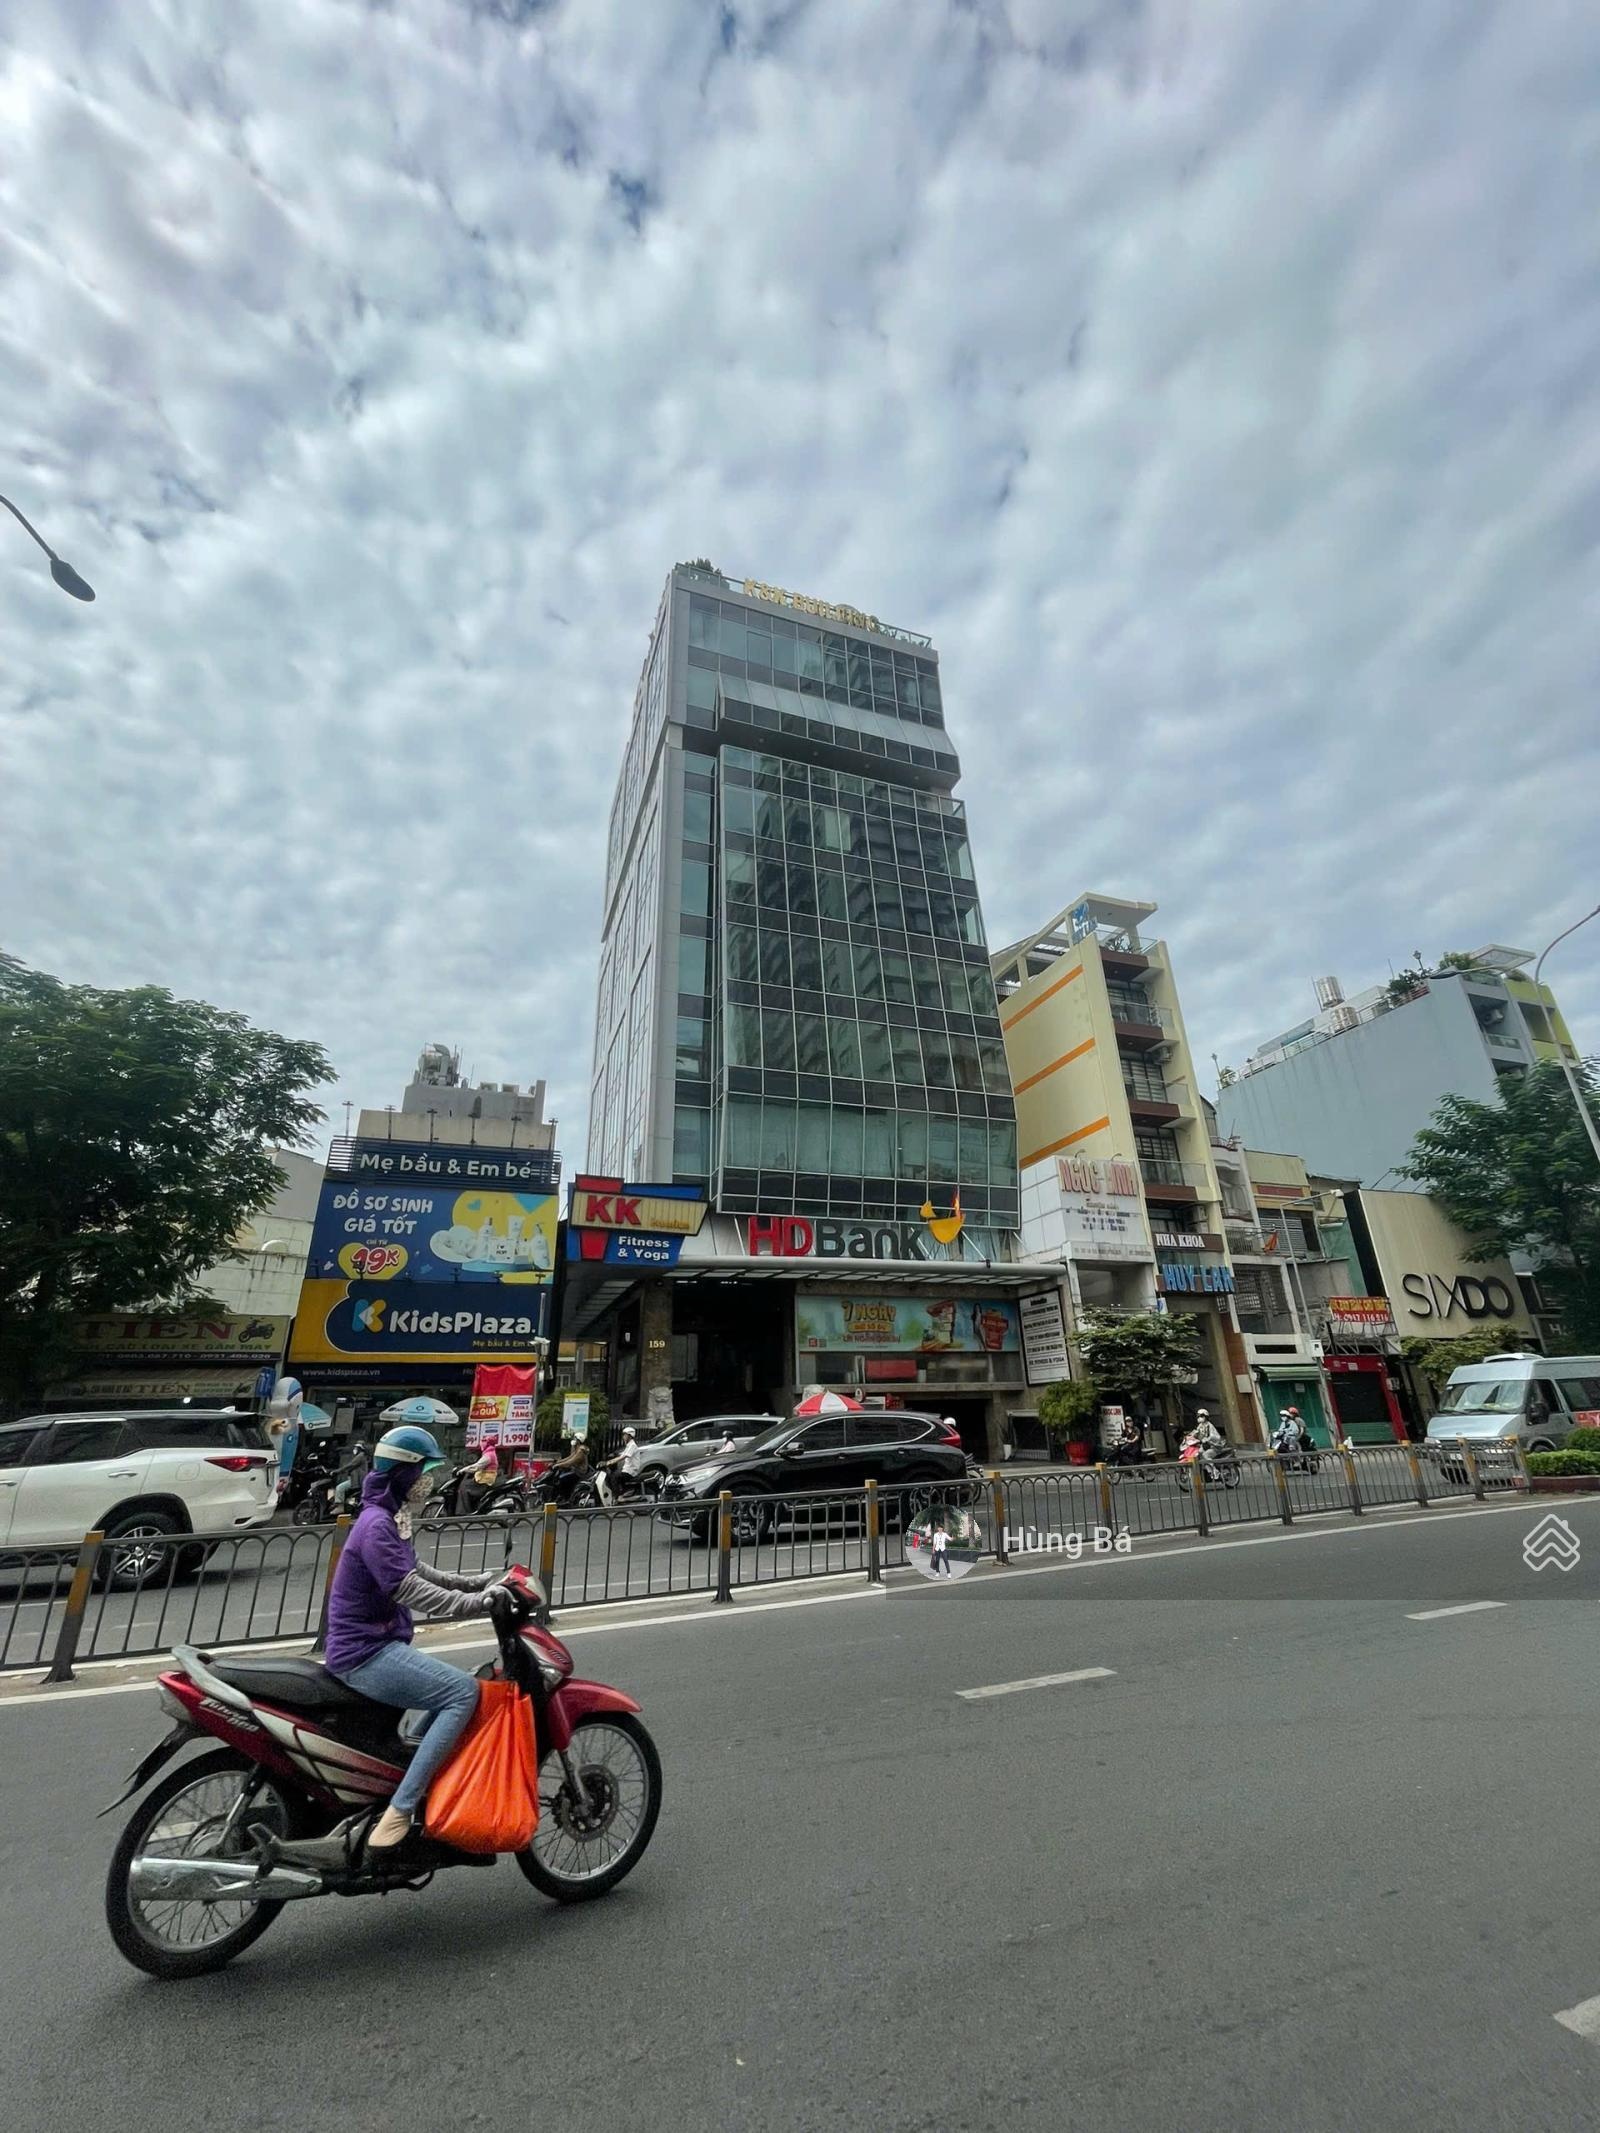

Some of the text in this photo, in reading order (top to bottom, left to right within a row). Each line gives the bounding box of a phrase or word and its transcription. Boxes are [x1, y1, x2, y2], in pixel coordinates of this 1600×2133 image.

[360, 1152, 532, 1179] Mẹ bầu & Em bé
[333, 1188, 434, 1214] ĐỒ SƠ SINH
[585, 1195, 641, 1225] KK
[382, 1213, 418, 1235] TỐT
[618, 1235, 670, 1248] Fitness
[748, 1215, 926, 1261] HDBank
[1177, 1234, 1206, 1248] KHOA
[617, 1247, 670, 1260] & Yoga
[1162, 1263, 1196, 1291] HUY
[1402, 1272, 1516, 1320] SIXDO
[649, 1340, 666, 1349] 159
